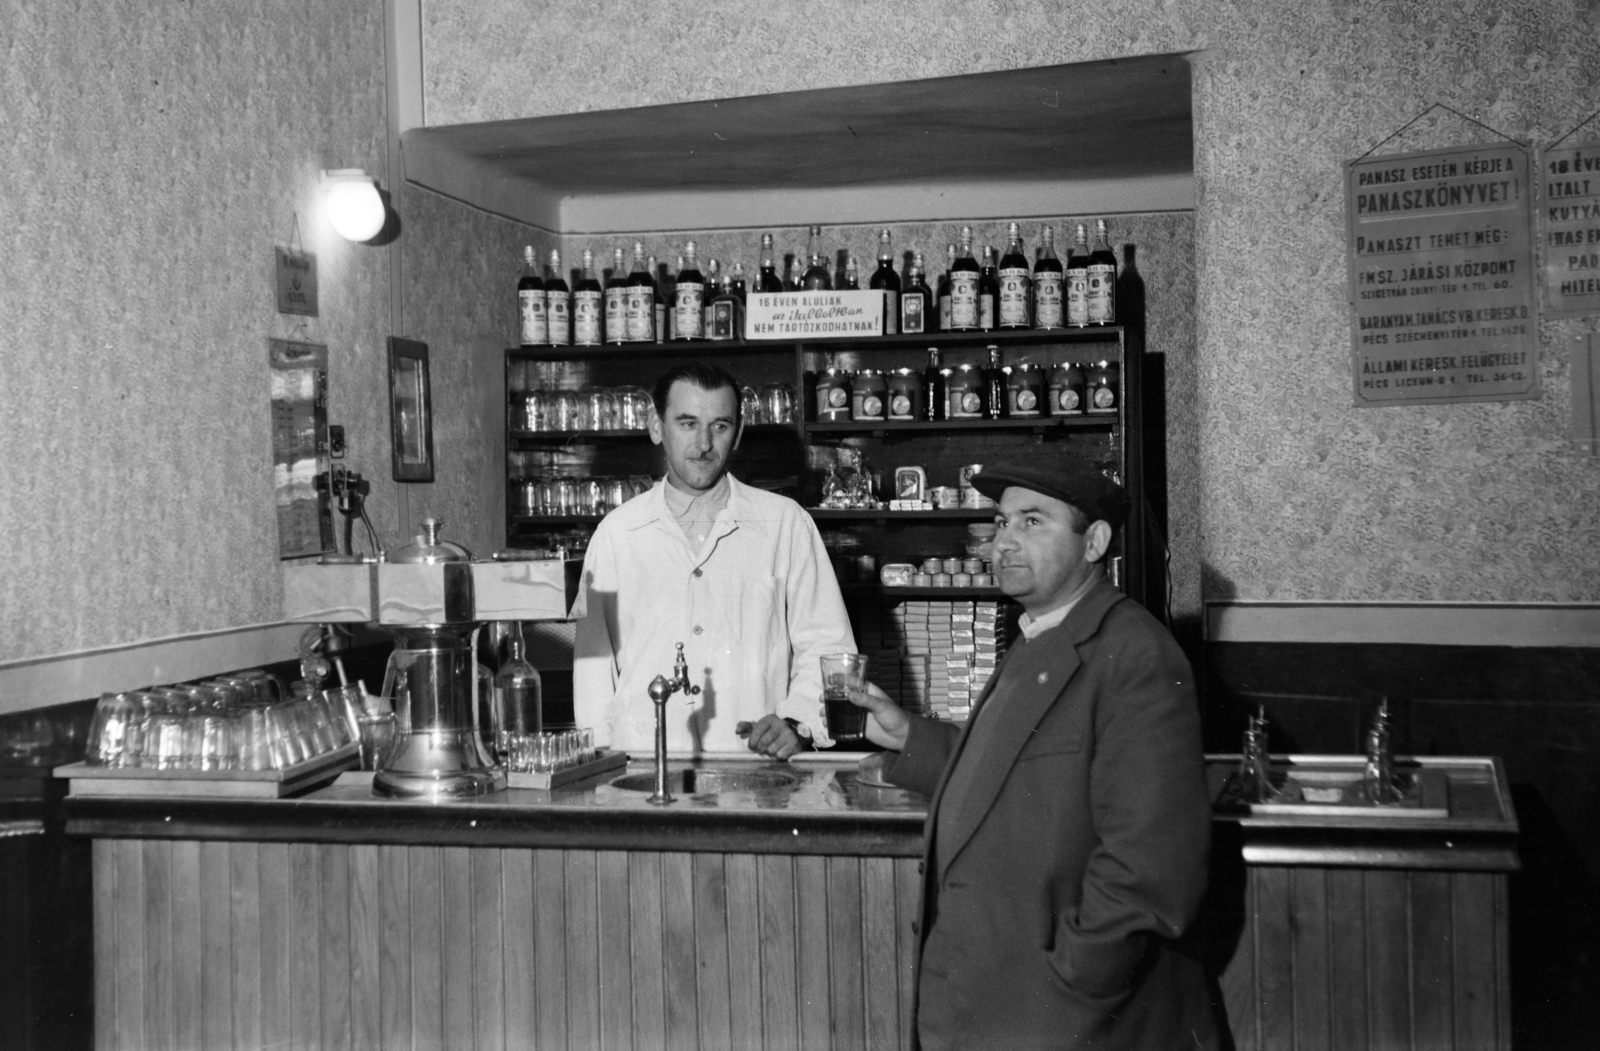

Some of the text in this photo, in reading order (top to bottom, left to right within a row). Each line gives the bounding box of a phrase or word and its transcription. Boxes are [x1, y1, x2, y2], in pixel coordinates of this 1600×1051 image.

[1360, 156, 1513, 185] PANASZ ESETÉN KÉRJE A
[1549, 160, 1568, 174] 18
[1358, 177, 1519, 213] PANASZKÖNYVET!
[1549, 180, 1590, 196] ITALT
[1357, 236, 1421, 254] PANASZT
[1430, 232, 1469, 247] TEHET
[1402, 261, 1450, 281] JÁRÁSI
[1455, 260, 1516, 278] KÖZPONT
[759, 295, 841, 306] 16 ÉVEN ALULIAK
[754, 316, 878, 333] NEM TARTÓZKODHATNAK!
[1363, 331, 1388, 345] PÉCS
[1363, 350, 1526, 374] ÁLLAMI KERESK. FELÜGYELET
[1364, 378, 1388, 388] PÉCS
[1467, 374, 1489, 383] TEL.
